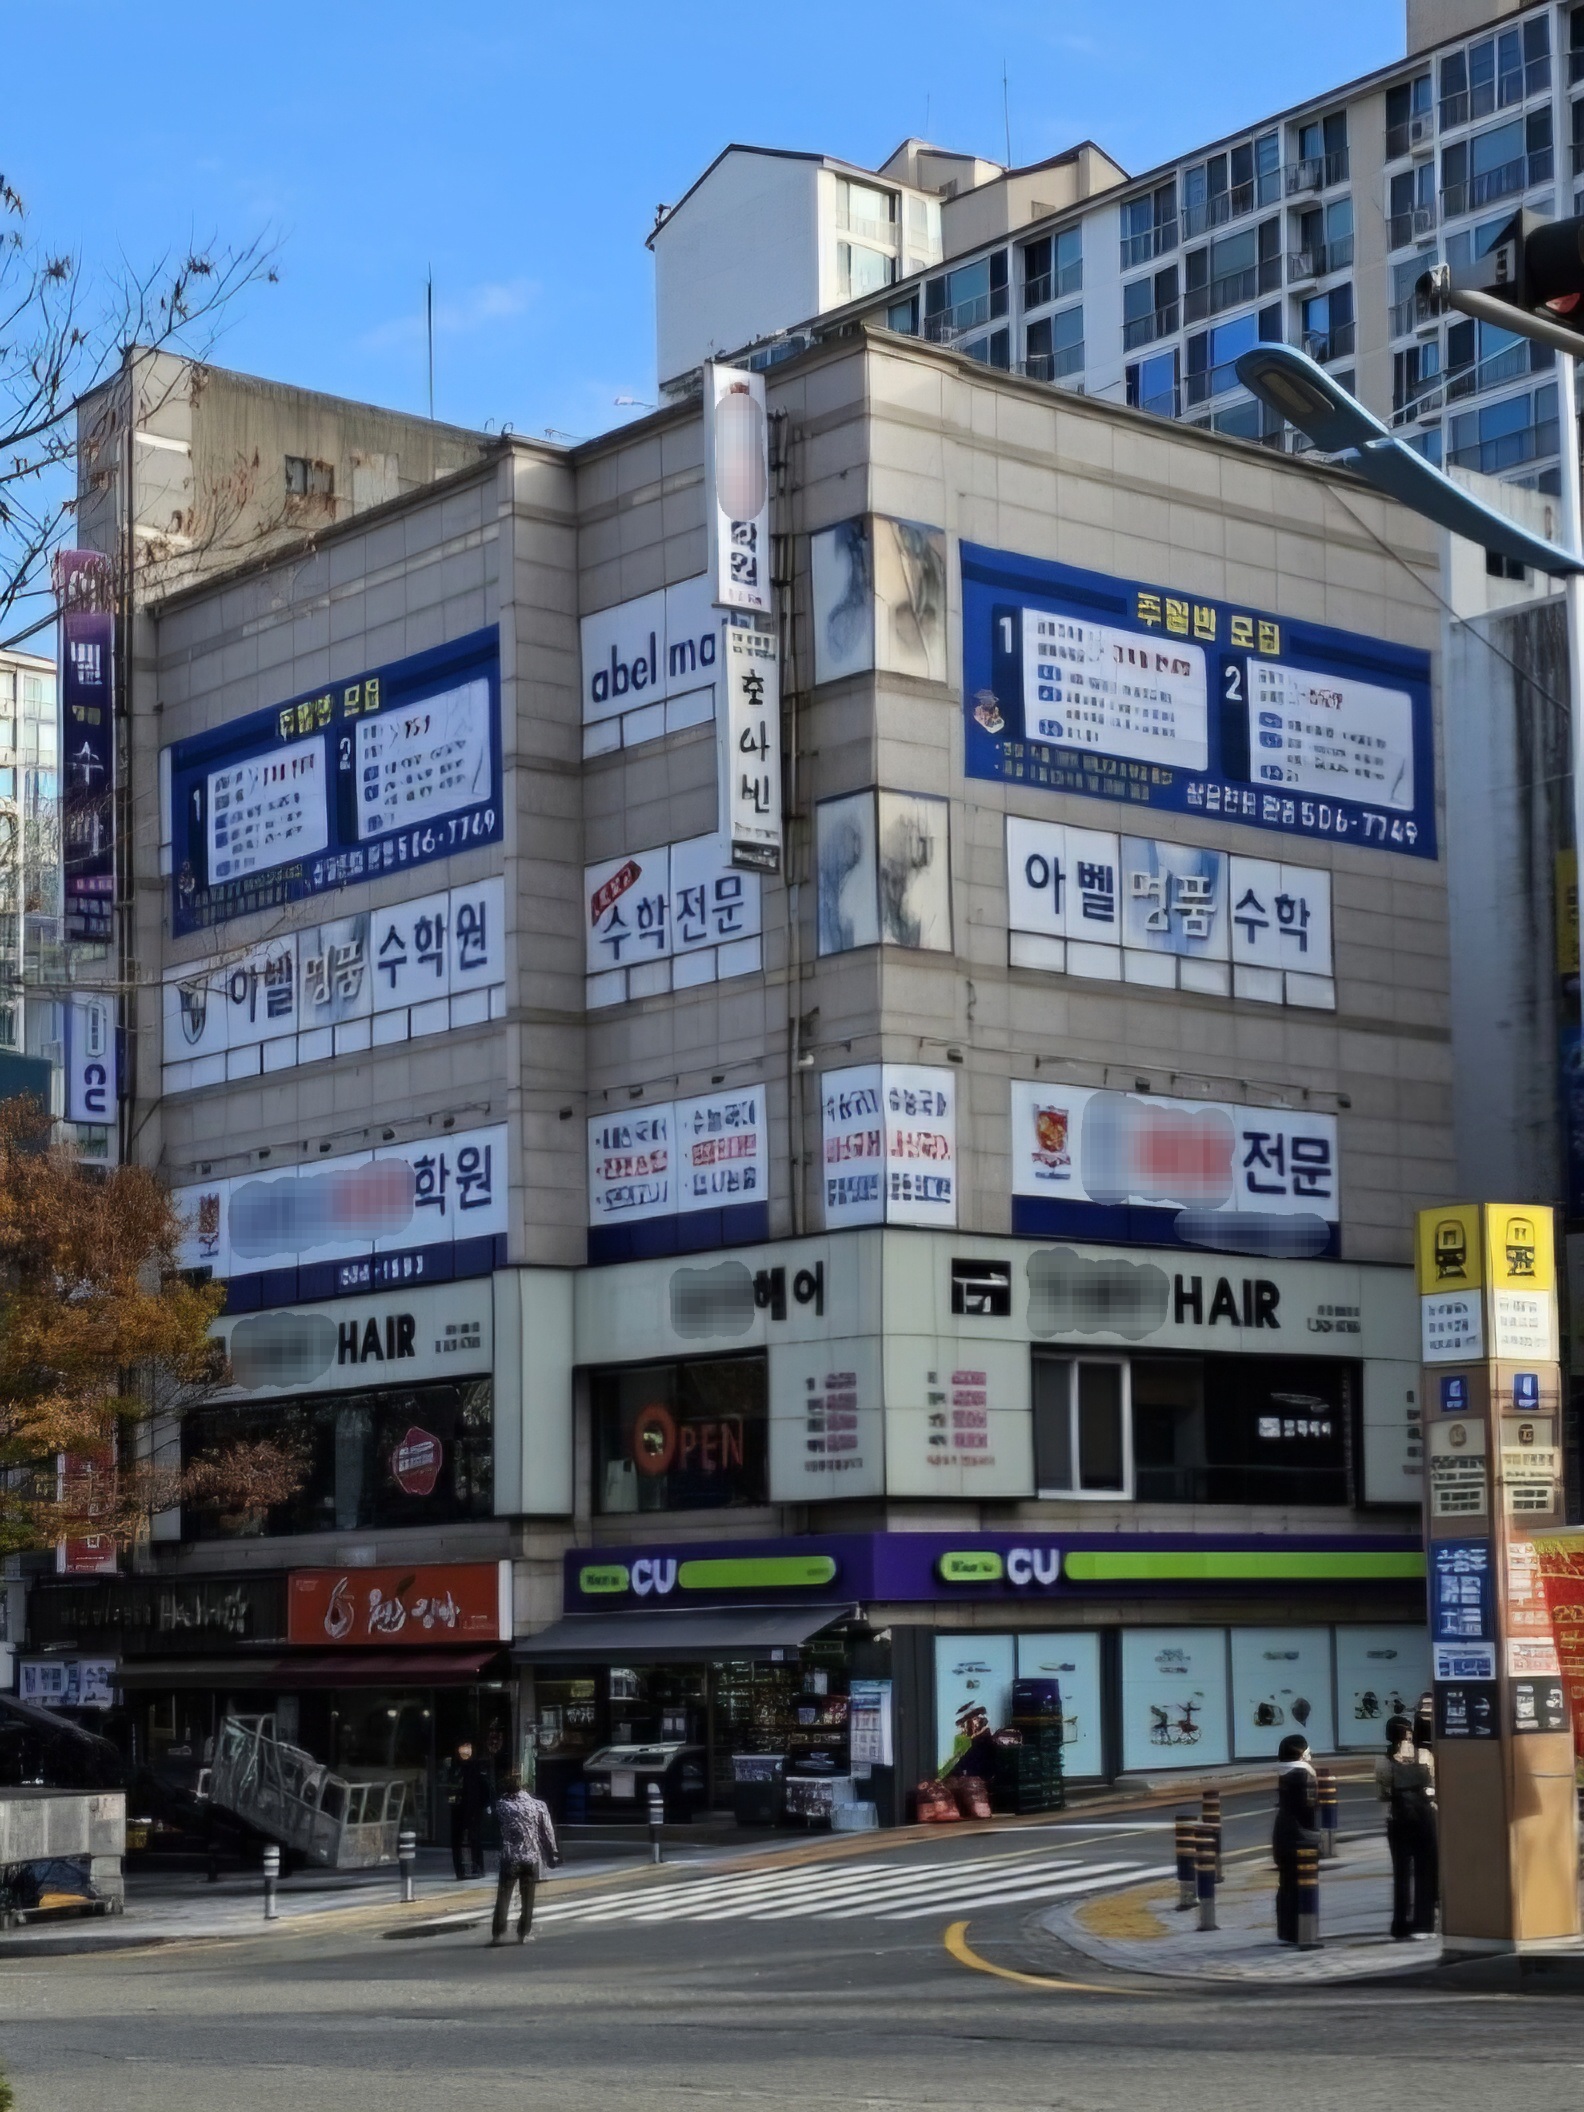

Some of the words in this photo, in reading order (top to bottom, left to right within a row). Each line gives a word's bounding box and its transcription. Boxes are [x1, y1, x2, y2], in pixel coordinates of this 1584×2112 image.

[999, 617, 1012, 654] 1
[592, 630, 657, 704] abel
[1225, 666, 1244, 702] 2
[339, 737, 352, 770] 2
[600, 875, 744, 960] 수학전문
[1025, 853, 1115, 923] 아벨
[1129, 866, 1218, 938] 명품
[1234, 888, 1311, 953] 수학
[378, 901, 489, 989] 수학원
[413, 1144, 493, 1217] 학원
[1242, 1131, 1333, 1199] 전문
[1174, 1273, 1281, 1329] HAIR
[338, 1313, 417, 1366] HAIR
[633, 1402, 744, 1477] OPEN
[631, 1558, 677, 1597] CU
[1007, 1548, 1060, 1586] CU
